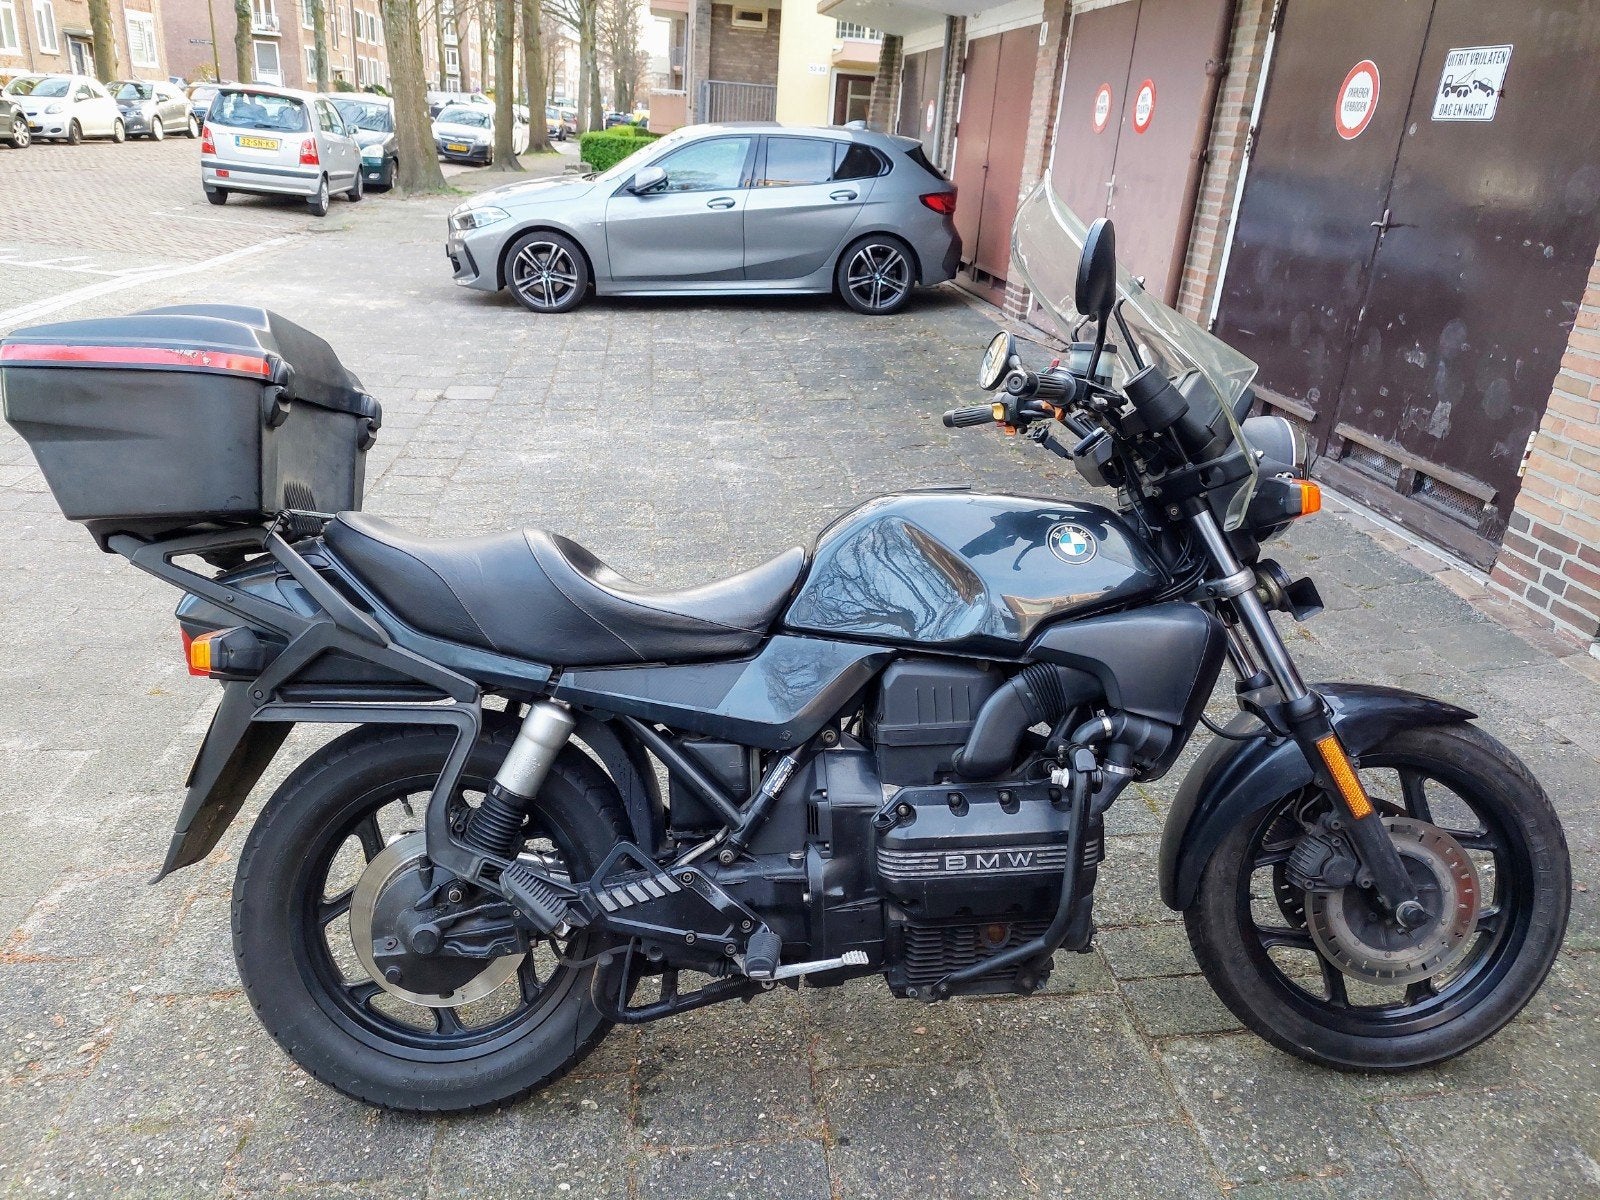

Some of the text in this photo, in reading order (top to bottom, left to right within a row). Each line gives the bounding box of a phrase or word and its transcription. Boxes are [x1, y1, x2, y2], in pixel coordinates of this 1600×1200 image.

[1447, 51, 1508, 67] UITRIT VRIJLATEN
[1347, 87, 1370, 99] PARKEREN
[1344, 101, 1368, 112] VERBODEN
[1439, 103, 1488, 116] DAG EN NACHT
[241, 137, 276, 149] 32-SN-KS
[1052, 526, 1089, 541] BMW
[945, 852, 1033, 871] BMW
